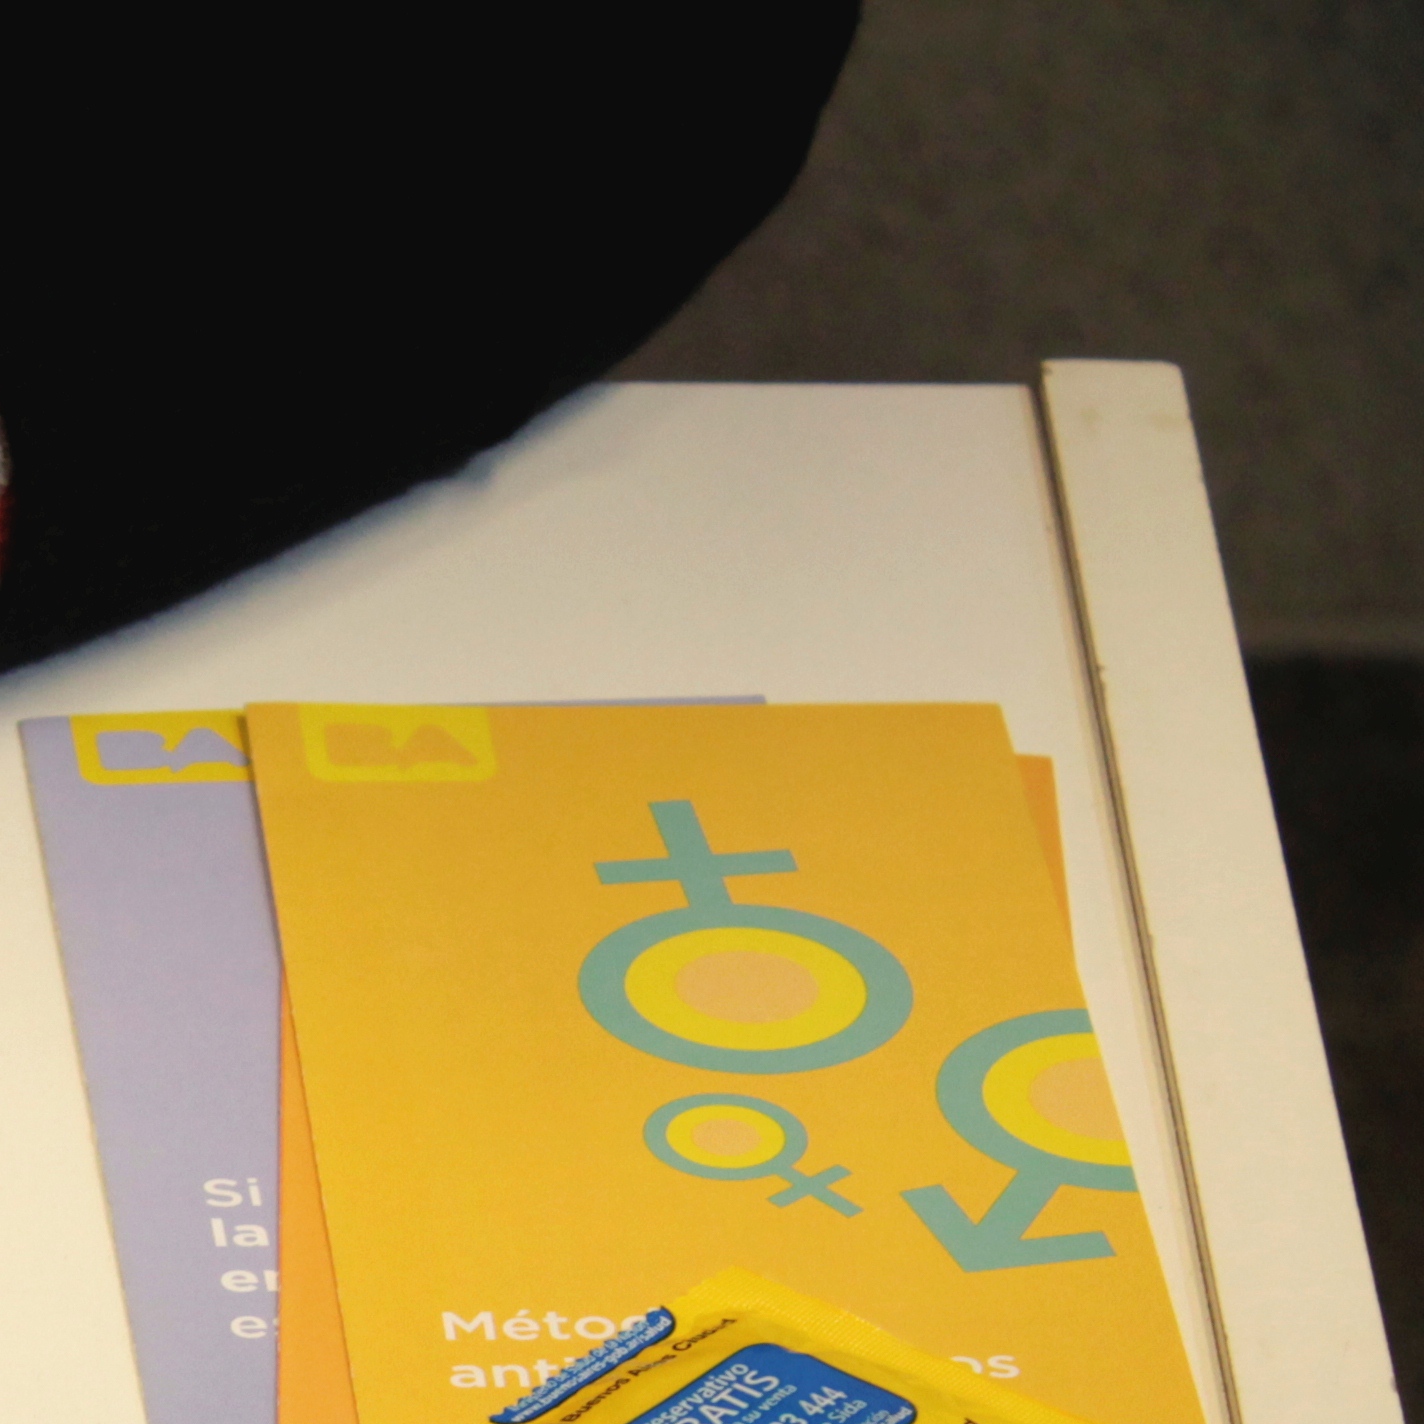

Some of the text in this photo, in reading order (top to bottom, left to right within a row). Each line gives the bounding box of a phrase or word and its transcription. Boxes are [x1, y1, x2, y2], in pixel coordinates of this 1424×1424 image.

[210, 1218, 270, 1247] la
[742, 1408, 762, 1424] su
[760, 1384, 798, 1414] venta
[798, 1386, 848, 1417] 444
[830, 1399, 867, 1424] Sida
